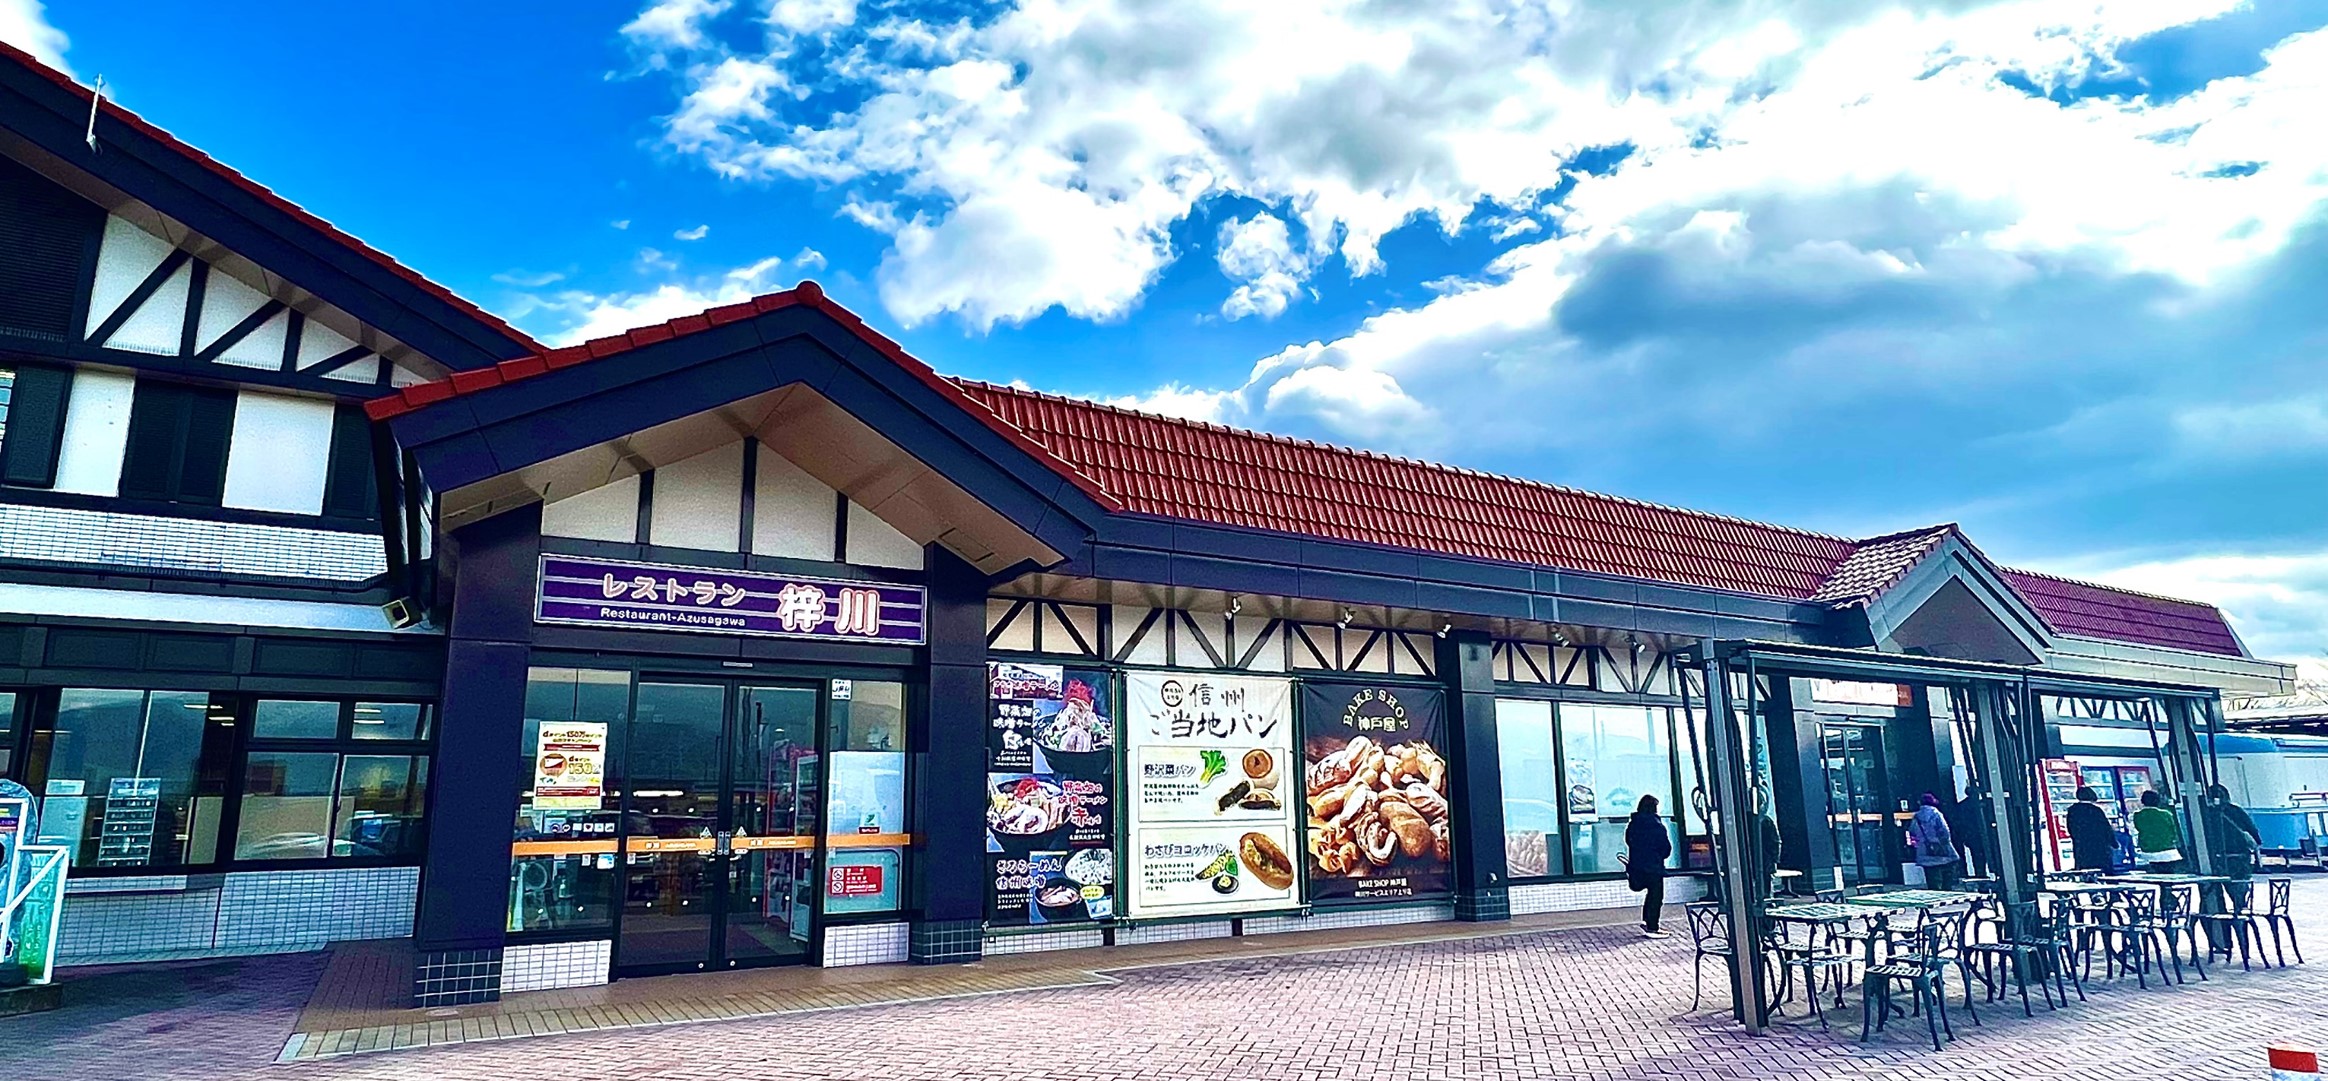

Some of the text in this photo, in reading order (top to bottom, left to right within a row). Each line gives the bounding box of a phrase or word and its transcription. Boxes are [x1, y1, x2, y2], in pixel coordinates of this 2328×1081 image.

[600, 607, 746, 627] Restaurant-Azusagawa
[602, 573, 881, 636] レストラン 梓川
[1189, 683, 1245, 712] 信州
[1343, 688, 1409, 730] BAKE SHOP
[1150, 709, 1278, 739] ご当地パン
[1144, 763, 1197, 776] 野沢菜パン
